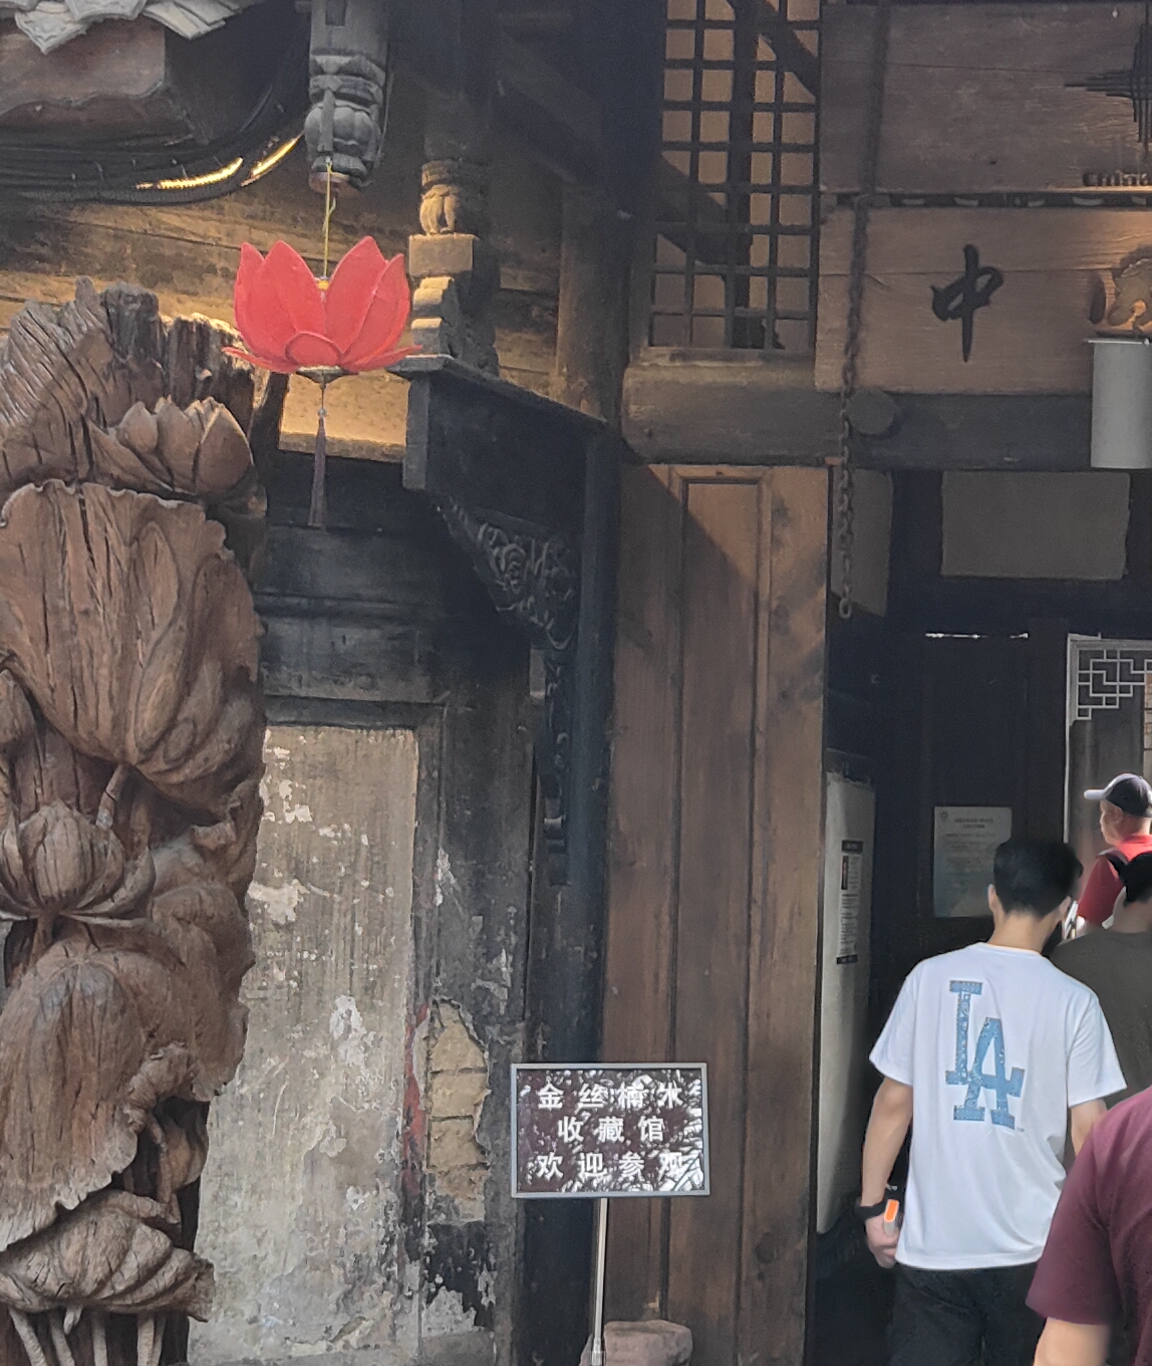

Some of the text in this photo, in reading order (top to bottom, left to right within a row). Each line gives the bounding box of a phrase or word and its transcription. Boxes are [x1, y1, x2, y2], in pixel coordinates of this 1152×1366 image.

[945, 979, 1026, 1130] LA
[537, 1083, 684, 1110] 金丝楠木
[557, 1115, 665, 1143] 收藏馆
[535, 1151, 685, 1181] 欢迎参观
